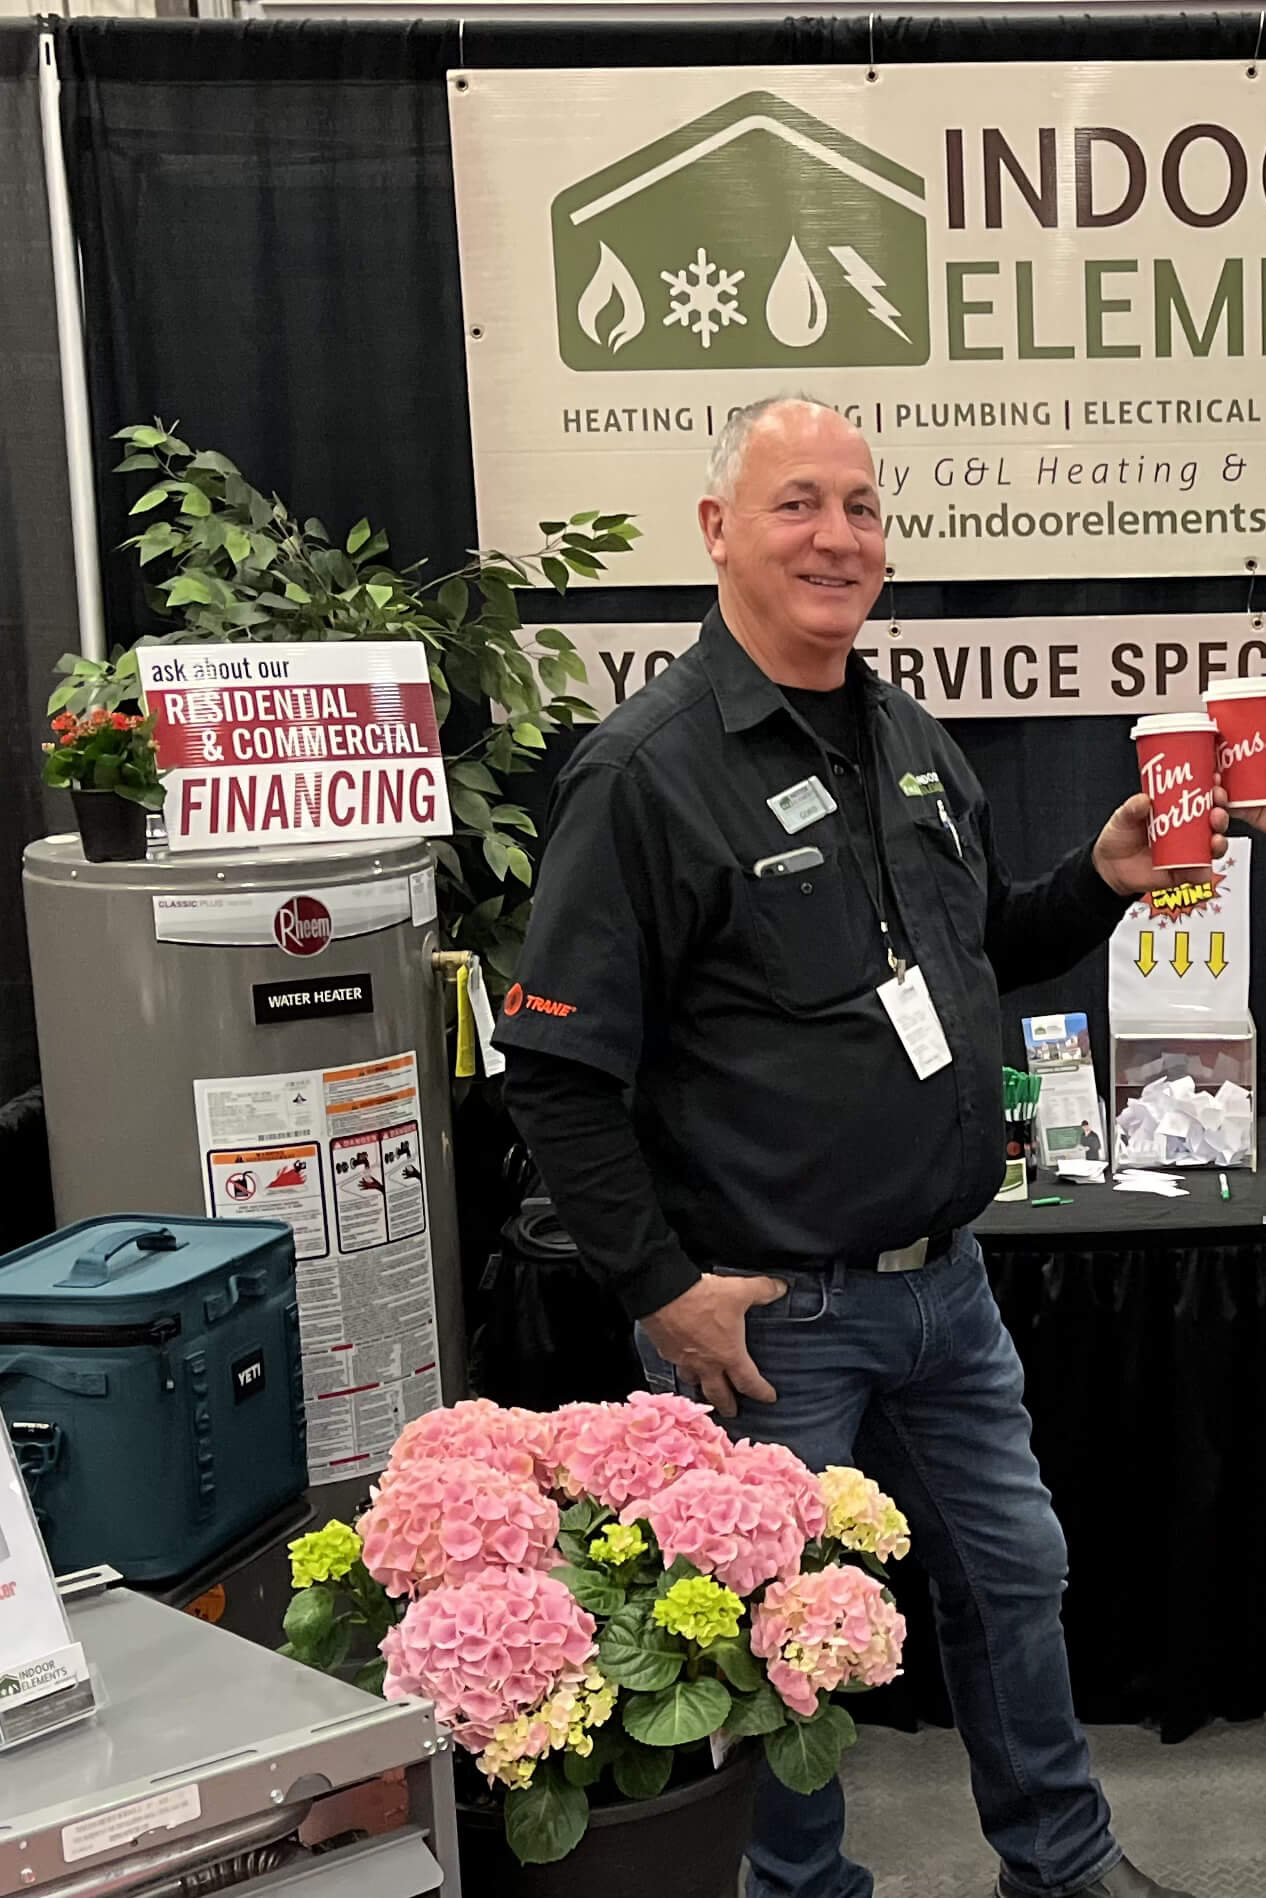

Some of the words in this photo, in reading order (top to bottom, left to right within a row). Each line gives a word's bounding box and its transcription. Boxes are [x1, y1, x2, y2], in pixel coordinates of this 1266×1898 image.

[564, 407, 694, 432] HEATING
[896, 402, 1051, 428] PLUMBING
[1084, 399, 1261, 425] ELECTRICAL
[935, 457, 1012, 487] G&L
[1037, 455, 1199, 491] Heating
[1222, 453, 1247, 482] &
[151, 659, 187, 682] ask
[193, 657, 250, 681] about
[258, 658, 290, 679] our
[165, 687, 357, 725] RESIDENTIAL
[202, 728, 225, 762] &
[233, 722, 428, 761] COMMERCIAL
[1141, 752, 1194, 801] Tim
[180, 766, 436, 836] FINANCING
[158, 900, 198, 909] CLASSIC
[279, 896, 330, 948] Rheem
[268, 990, 312, 1008] WATER
[314, 986, 362, 1004] HEATER
[238, 1361, 261, 1387] YETI
[19, 1660, 56, 1681] INDOOR
[21, 1666, 68, 1692] ELEMENTS
